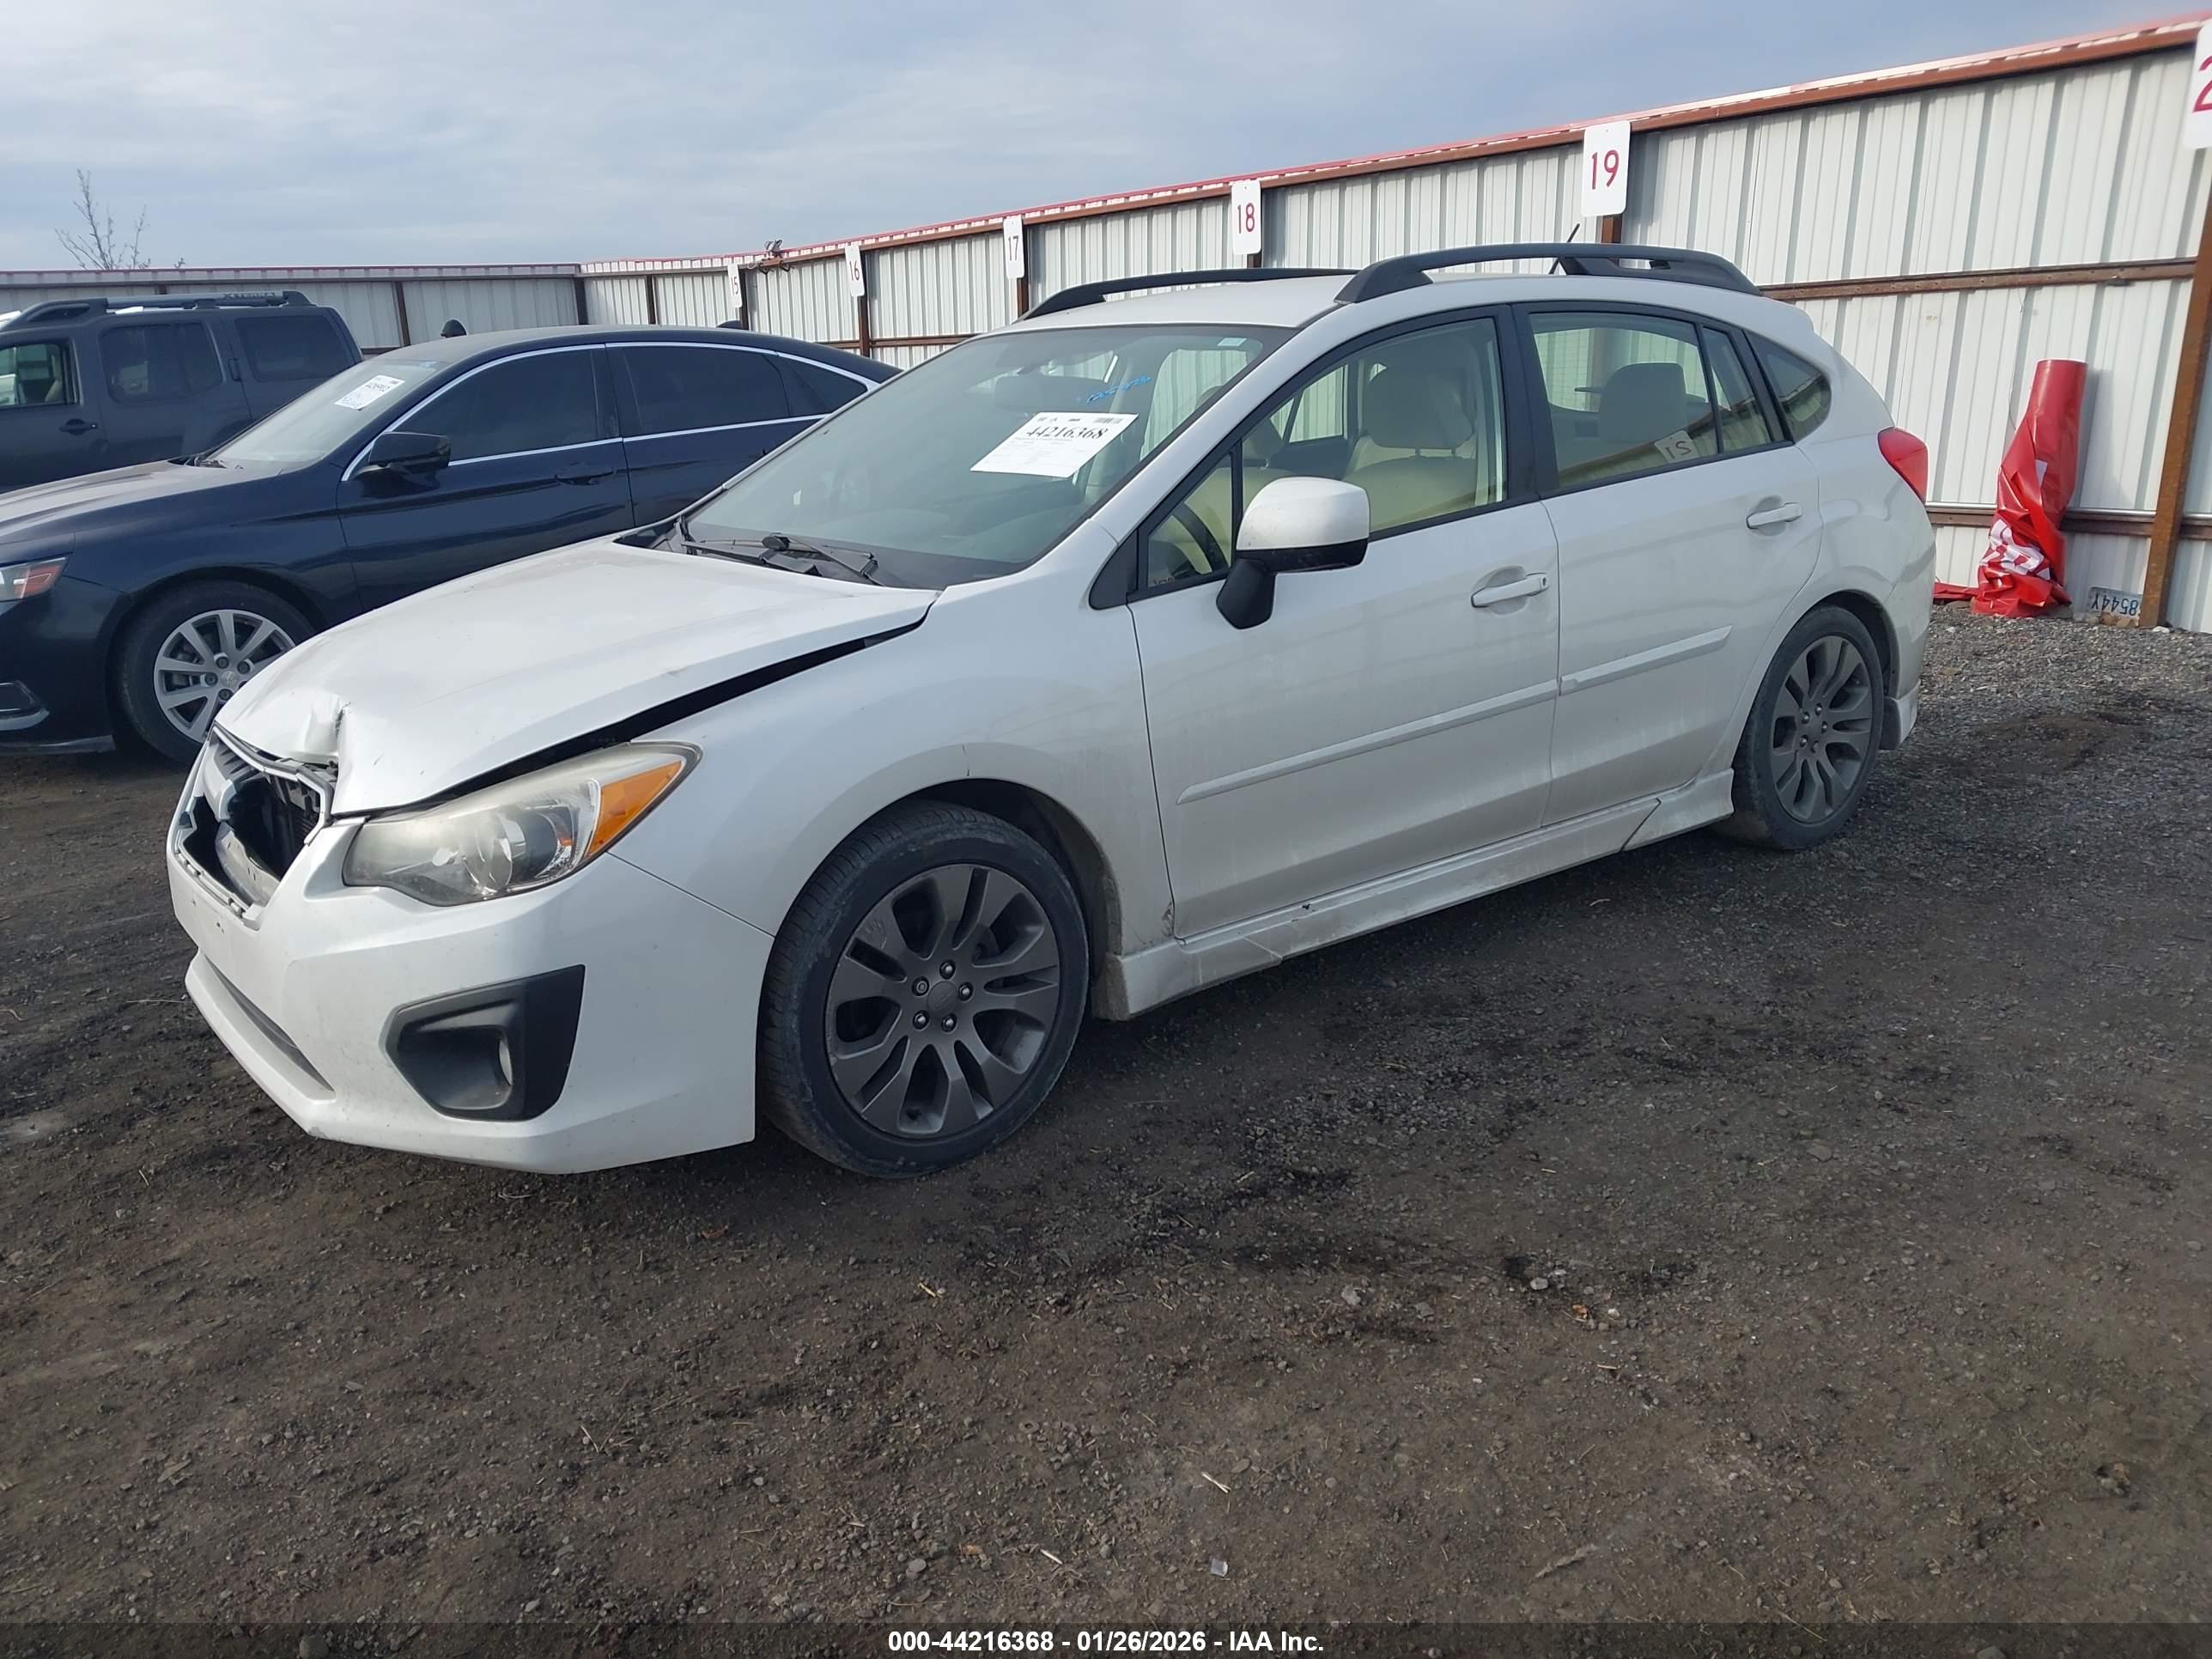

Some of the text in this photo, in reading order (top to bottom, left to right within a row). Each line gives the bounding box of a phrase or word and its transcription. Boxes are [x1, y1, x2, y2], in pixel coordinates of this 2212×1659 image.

[1591, 149, 1620, 190] 19
[1237, 202, 1255, 234] 18
[1008, 234, 1019, 261] 17
[849, 260, 860, 282] 16
[731, 276, 739, 295] 15
[1026, 426, 1109, 440] 44216368
